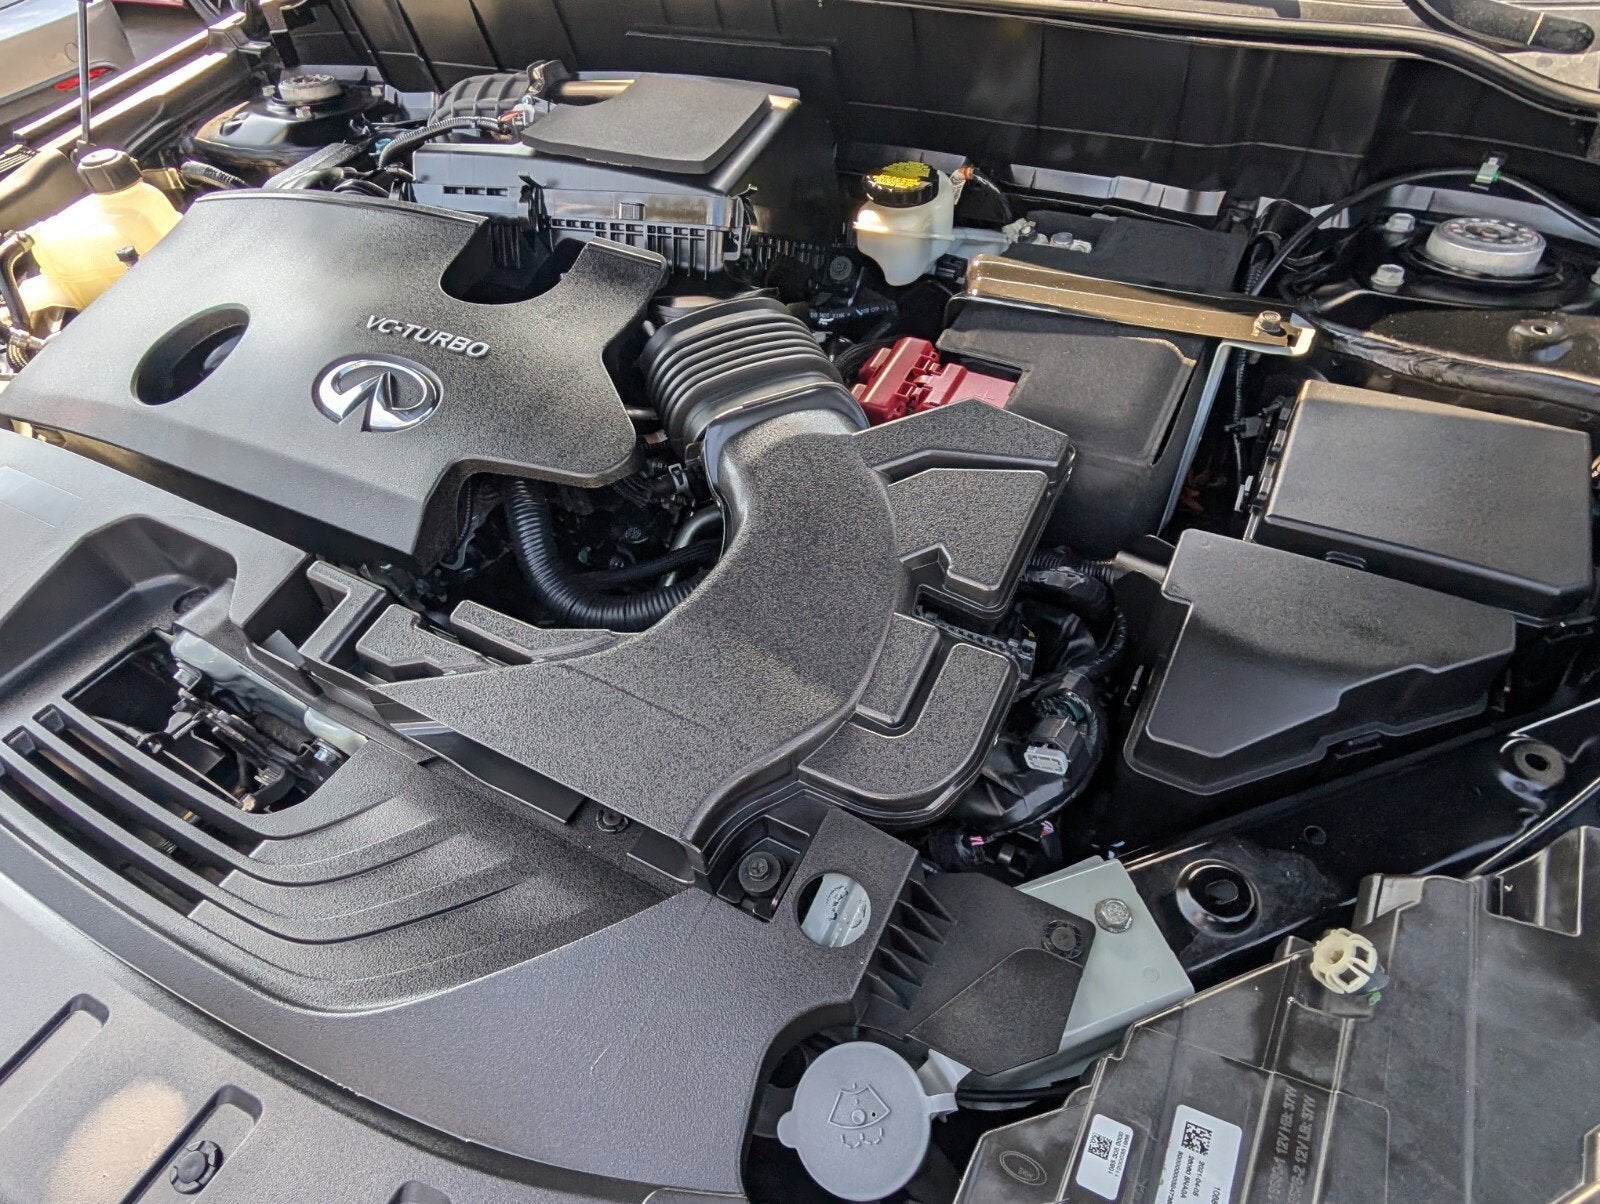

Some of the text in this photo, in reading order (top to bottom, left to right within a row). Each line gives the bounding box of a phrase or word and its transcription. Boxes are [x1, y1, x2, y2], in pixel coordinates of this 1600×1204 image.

[366, 315, 490, 357] VC-TURBO
[1283, 1085, 1297, 1111] 37W
[1301, 1094, 1316, 1121] 37W
